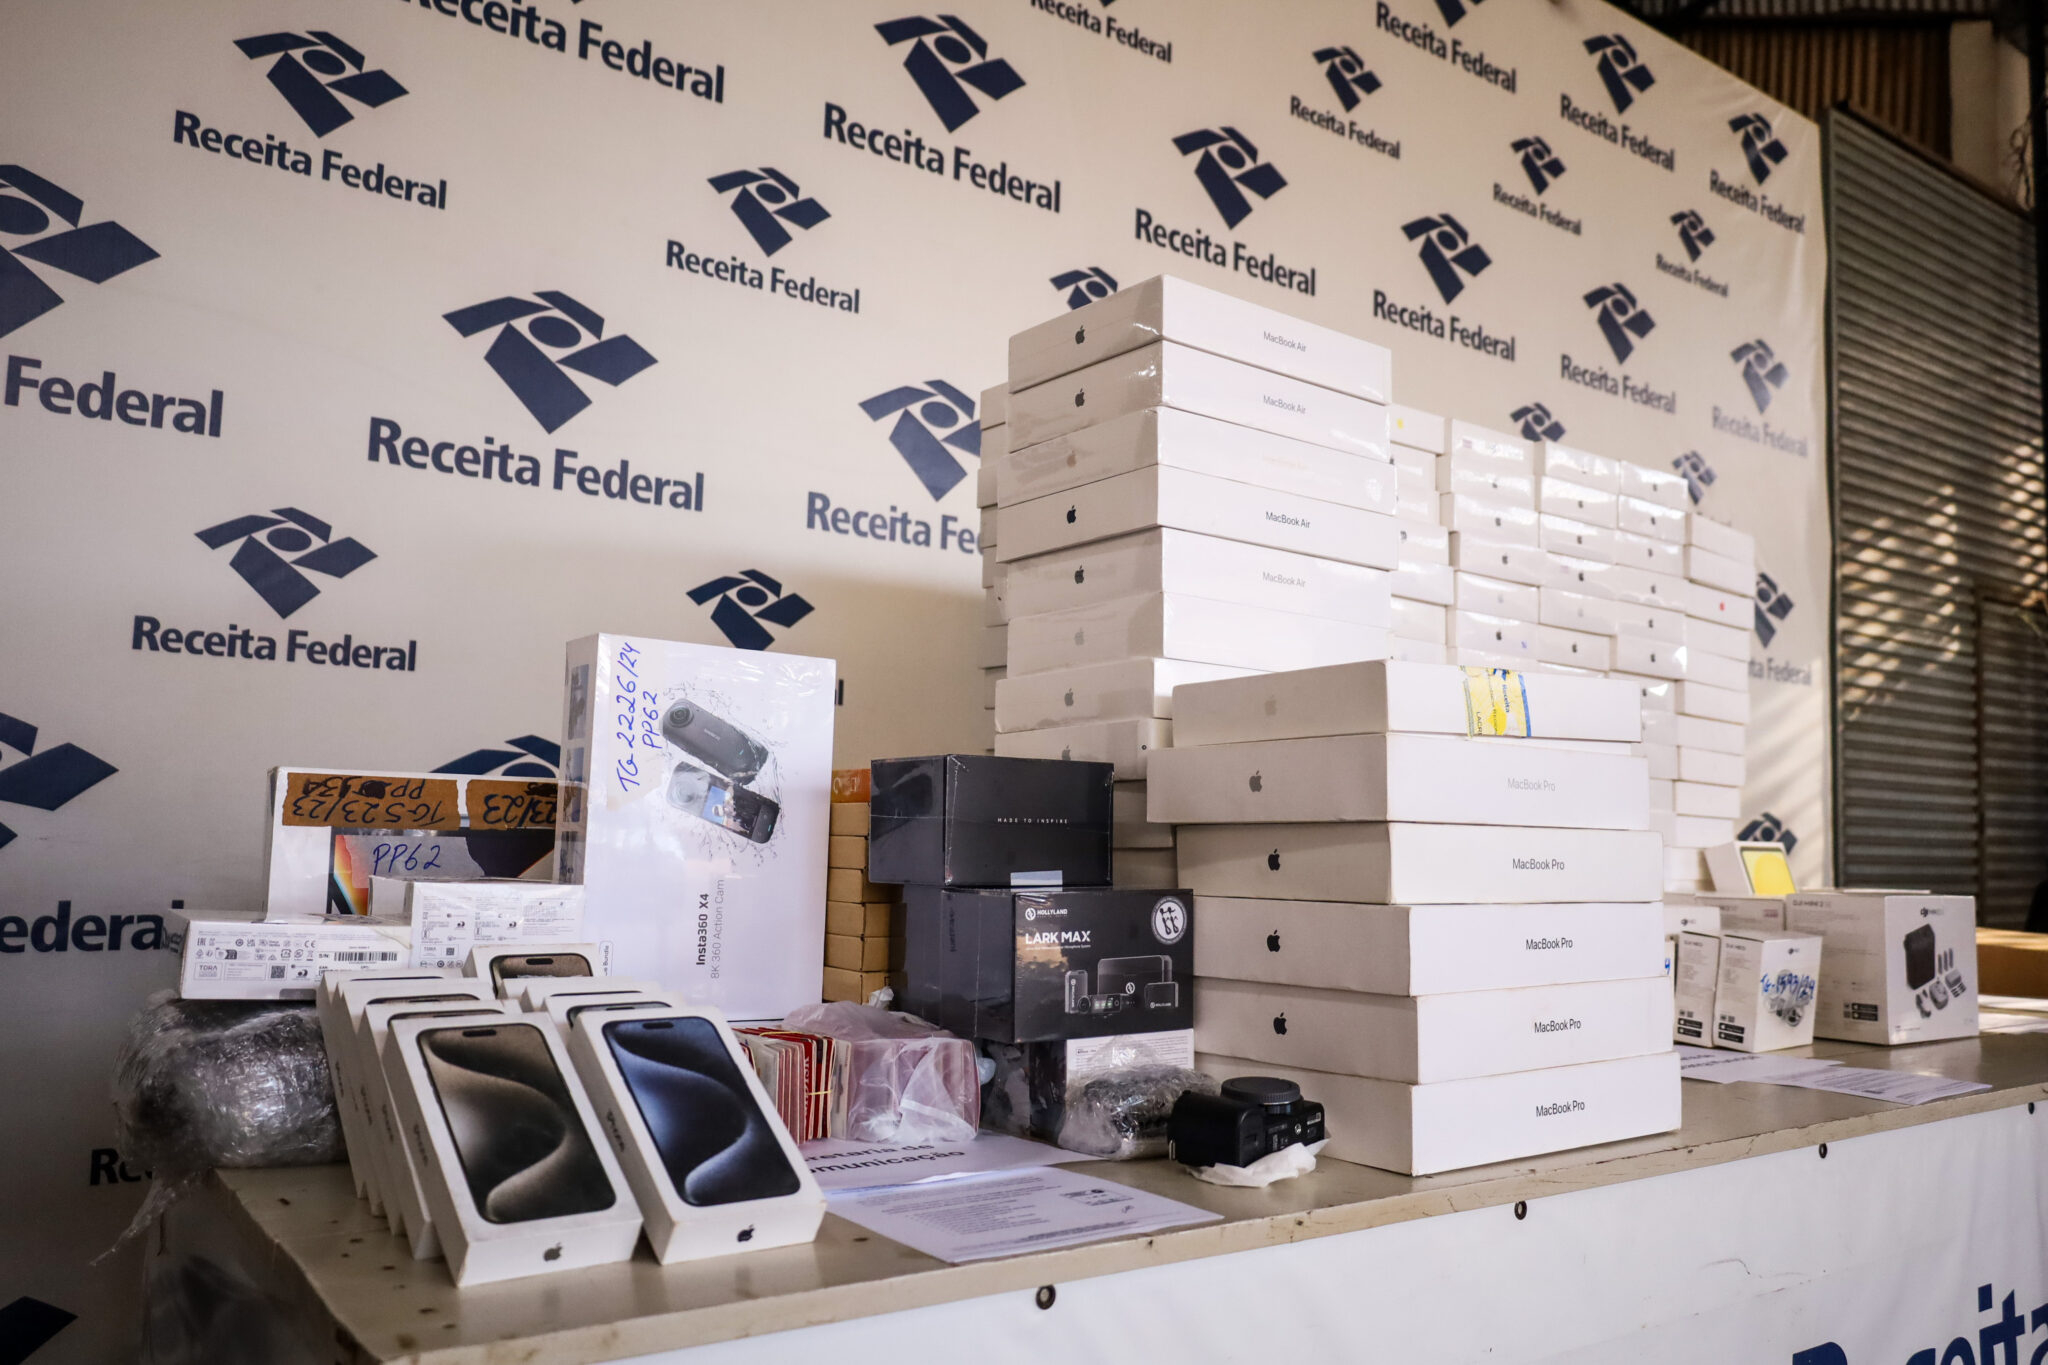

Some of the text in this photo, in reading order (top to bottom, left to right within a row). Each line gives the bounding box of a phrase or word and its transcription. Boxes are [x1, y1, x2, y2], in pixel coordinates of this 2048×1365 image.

[405, 0, 724, 103] eceita Federal
[1106, 17, 1171, 63] Federal
[1376, 2, 1516, 93] Receita Federal
[1291, 96, 1400, 159] Receita Federal
[1561, 94, 1674, 171] Receita Federal
[174, 110, 446, 209] Receita Federal
[824, 102, 1060, 213] Receita Federal
[1494, 184, 1581, 235] Receita Federal
[1711, 170, 1804, 232] Receita Federal
[667, 240, 859, 313] Receita Federal
[1136, 209, 1315, 296] Receita Federal
[1656, 254, 1728, 297] Receita Federal
[1264, 331, 1306, 352] MacBook Air
[1374, 290, 1515, 361] Receita Federal
[4, 355, 223, 437] Federal
[1264, 395, 1306, 414] MacBook Air
[1561, 354, 1675, 413] Receita Federal
[1712, 406, 1807, 458] Receita Federal
[368, 417, 704, 511] Receita Federal
[807, 492, 930, 547] Receita
[1266, 512, 1310, 528] MacBook Air
[1263, 572, 1306, 587] MacBook Air
[132, 616, 416, 671] Receita Federal
[1767, 656, 1812, 685] Federal
[1508, 778, 1555, 791] MacBook Pro
[372, 842, 442, 876] PP62
[1513, 858, 1564, 870] MacBook Pro
[0, 900, 184, 954] edera
[696, 894, 709, 965] Insta360 X4
[710, 880, 724, 979] 8K 360 Action Cam
[1025, 930, 1091, 945] LARK MAX
[1036, 908, 1068, 916] HOLLYLAND
[1526, 938, 1573, 949] MacBook Pro
[1535, 1019, 1581, 1033] MacBook Pro
[1536, 1100, 1585, 1116] MacBook Pro
[804, 1147, 896, 1162] retaria
[809, 1150, 966, 1174] municação
